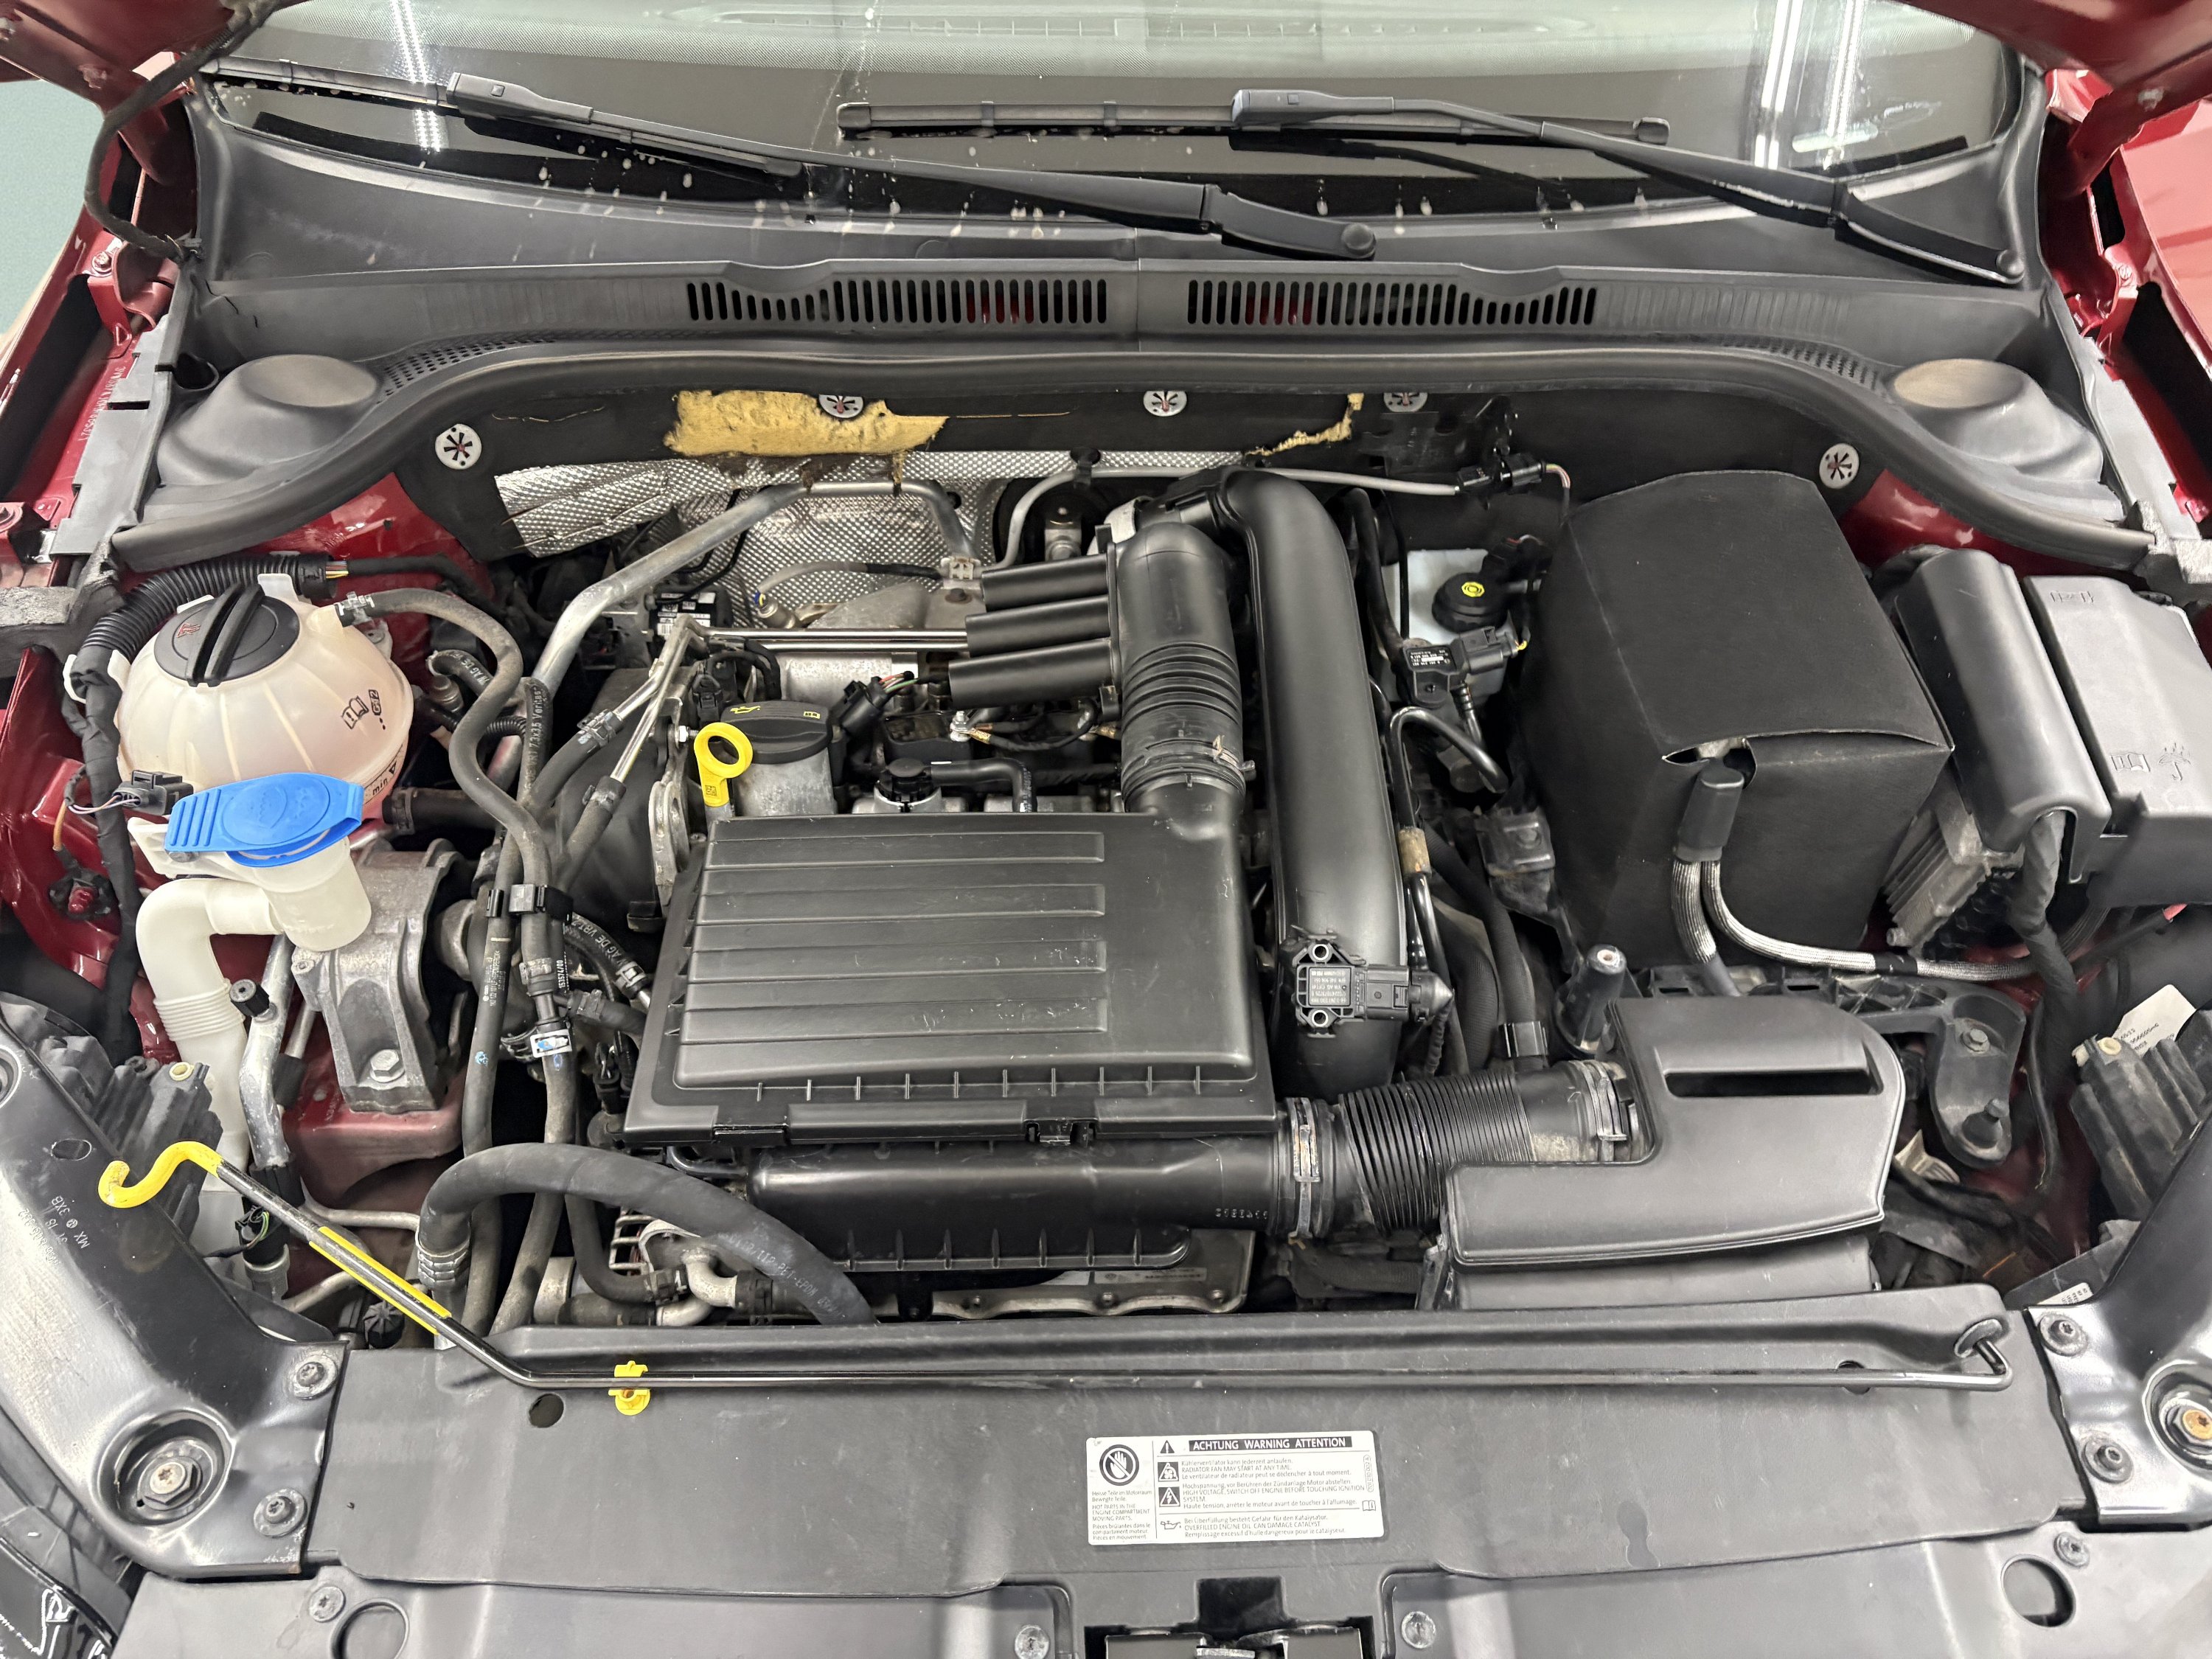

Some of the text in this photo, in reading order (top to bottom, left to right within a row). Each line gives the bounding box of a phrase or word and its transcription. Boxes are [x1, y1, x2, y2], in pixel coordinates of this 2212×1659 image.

[370, 690, 380, 713] G12
[372, 776, 388, 796] min
[595, 934, 611, 947] DE
[608, 946, 622, 958] AG
[556, 959, 566, 989] 153574/00
[74, 1231, 90, 1248] MX
[1193, 1437, 1346, 1450] ACHTUNG WARNING ATTENTION
[1184, 1531, 1220, 1539] Remplissage
[1264, 1528, 1294, 1537] dangereux
